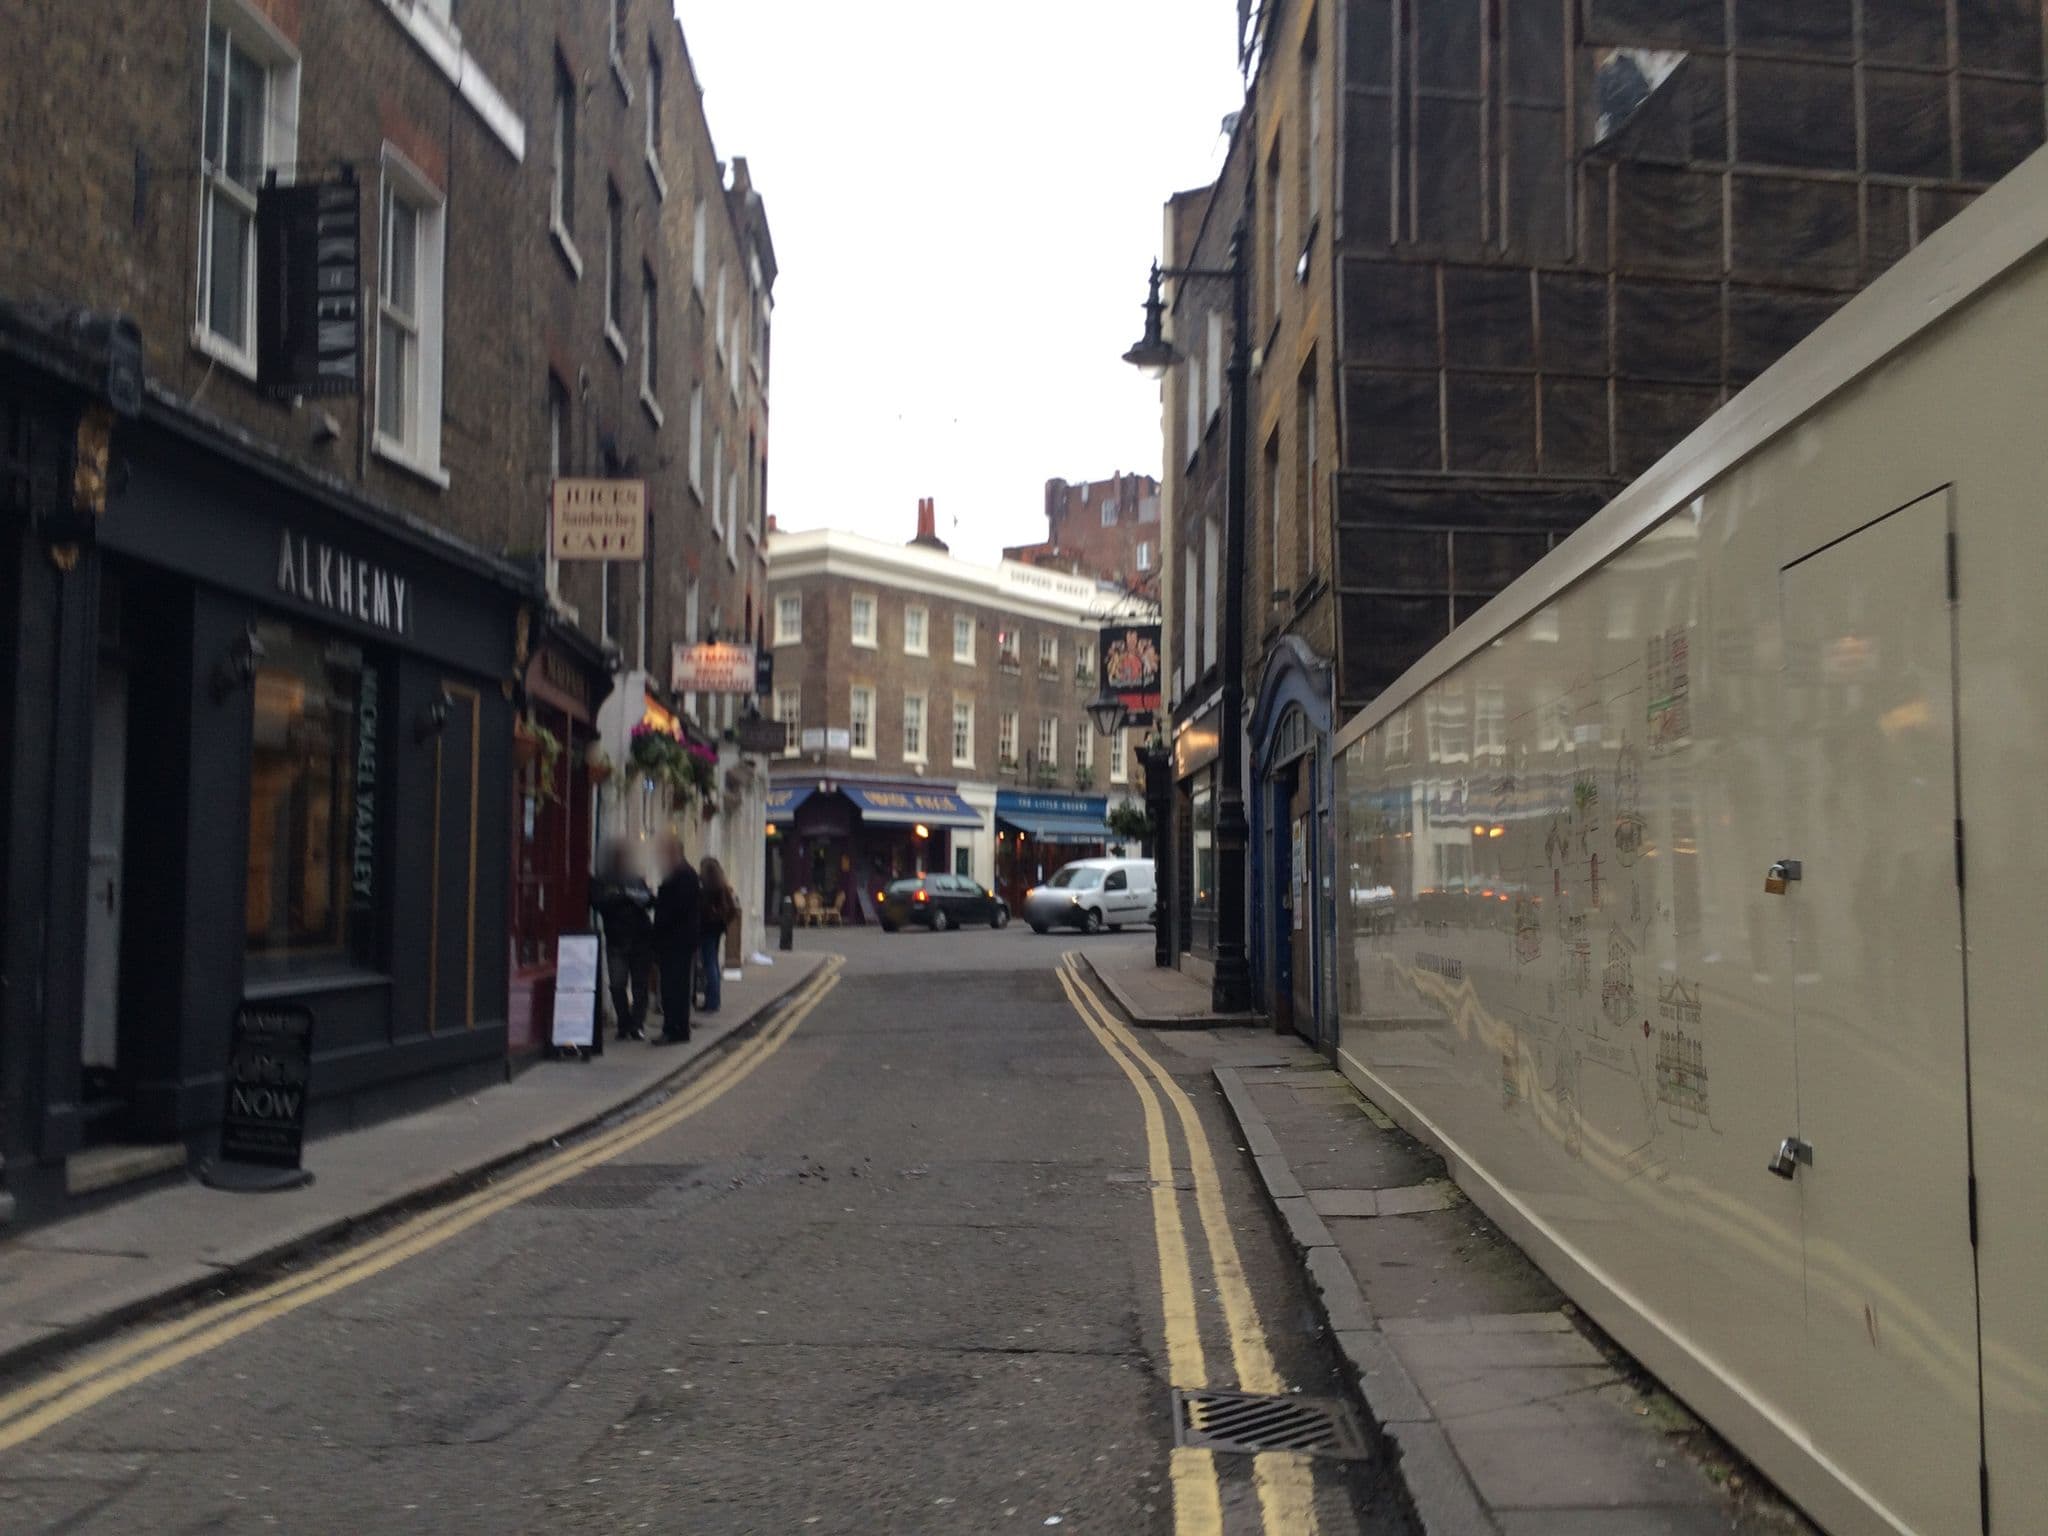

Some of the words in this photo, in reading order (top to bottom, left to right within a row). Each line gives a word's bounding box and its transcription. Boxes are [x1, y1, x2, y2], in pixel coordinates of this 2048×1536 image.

[564, 488, 637, 505] JUICES
[277, 527, 405, 634] ALKHEMY
[1056, 583, 1090, 600] MARKET
[705, 650, 749, 665] MAHAL
[232, 1086, 300, 1120] NOW
